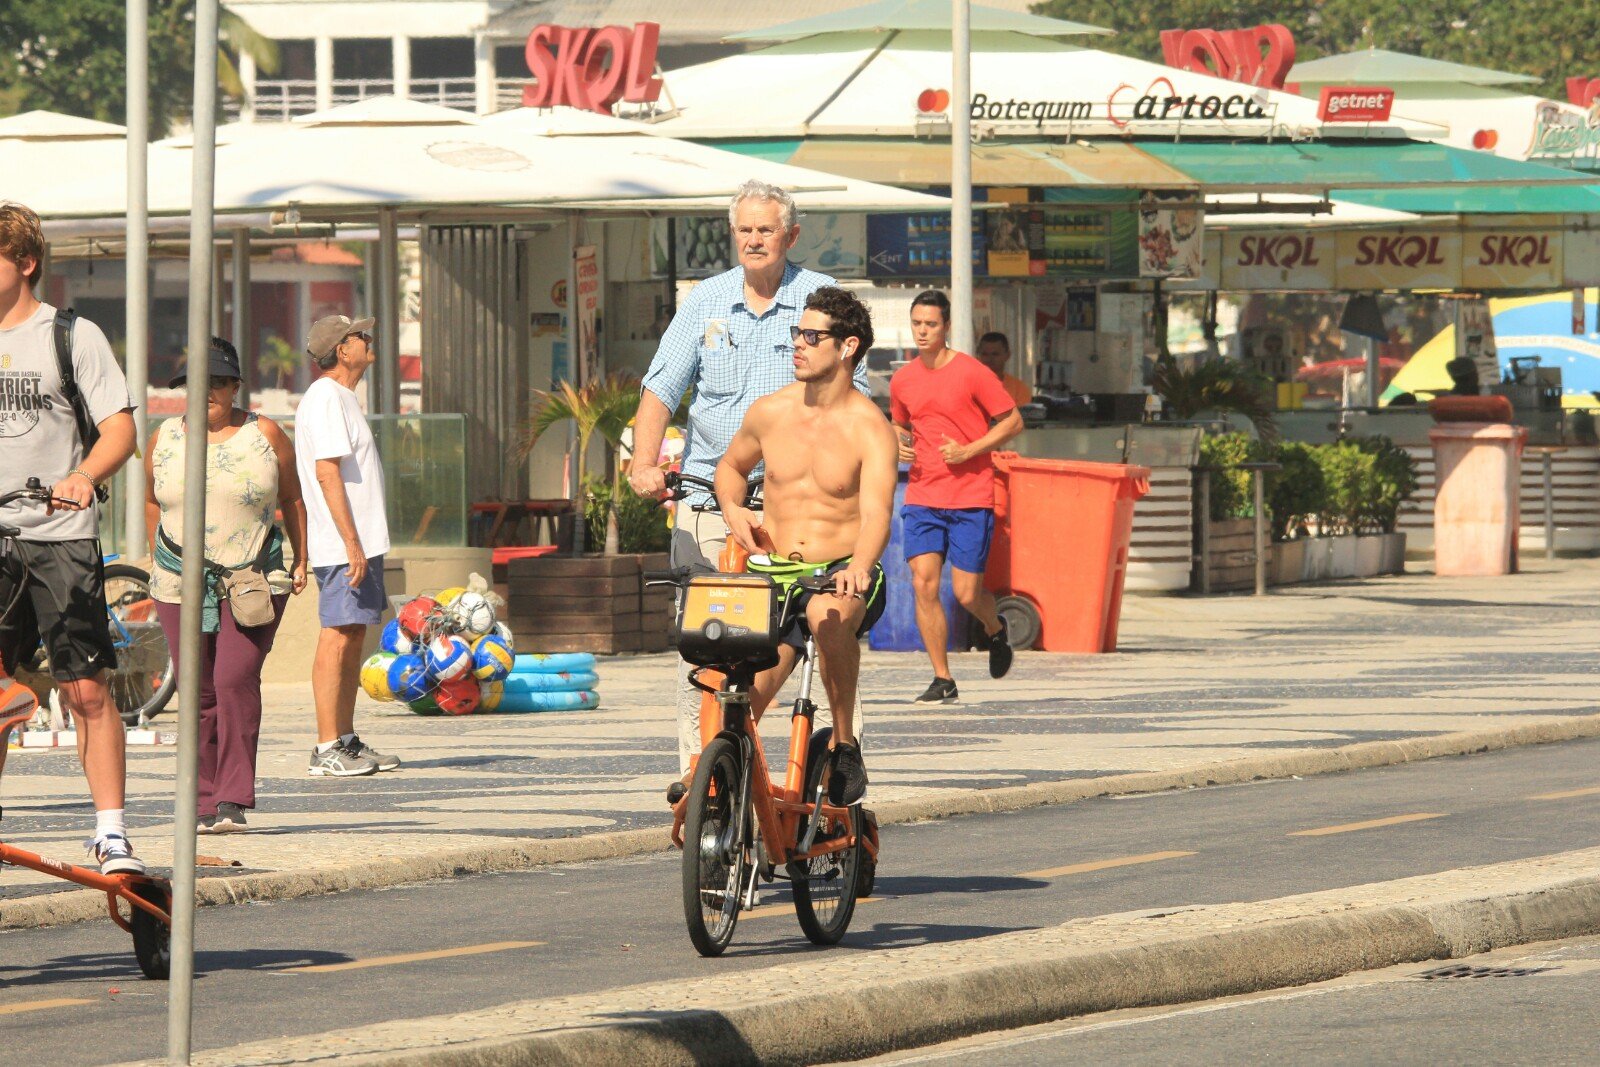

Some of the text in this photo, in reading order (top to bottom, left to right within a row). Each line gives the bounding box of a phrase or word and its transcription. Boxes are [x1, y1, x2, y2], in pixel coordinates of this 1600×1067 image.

[522, 22, 664, 116] SKOL
[970, 94, 1092, 128] Botequim
[1328, 93, 1385, 114] getnet
[1237, 234, 1320, 270] SKOL
[1355, 234, 1444, 269] SKOL
[1479, 234, 1551, 268] SKOL
